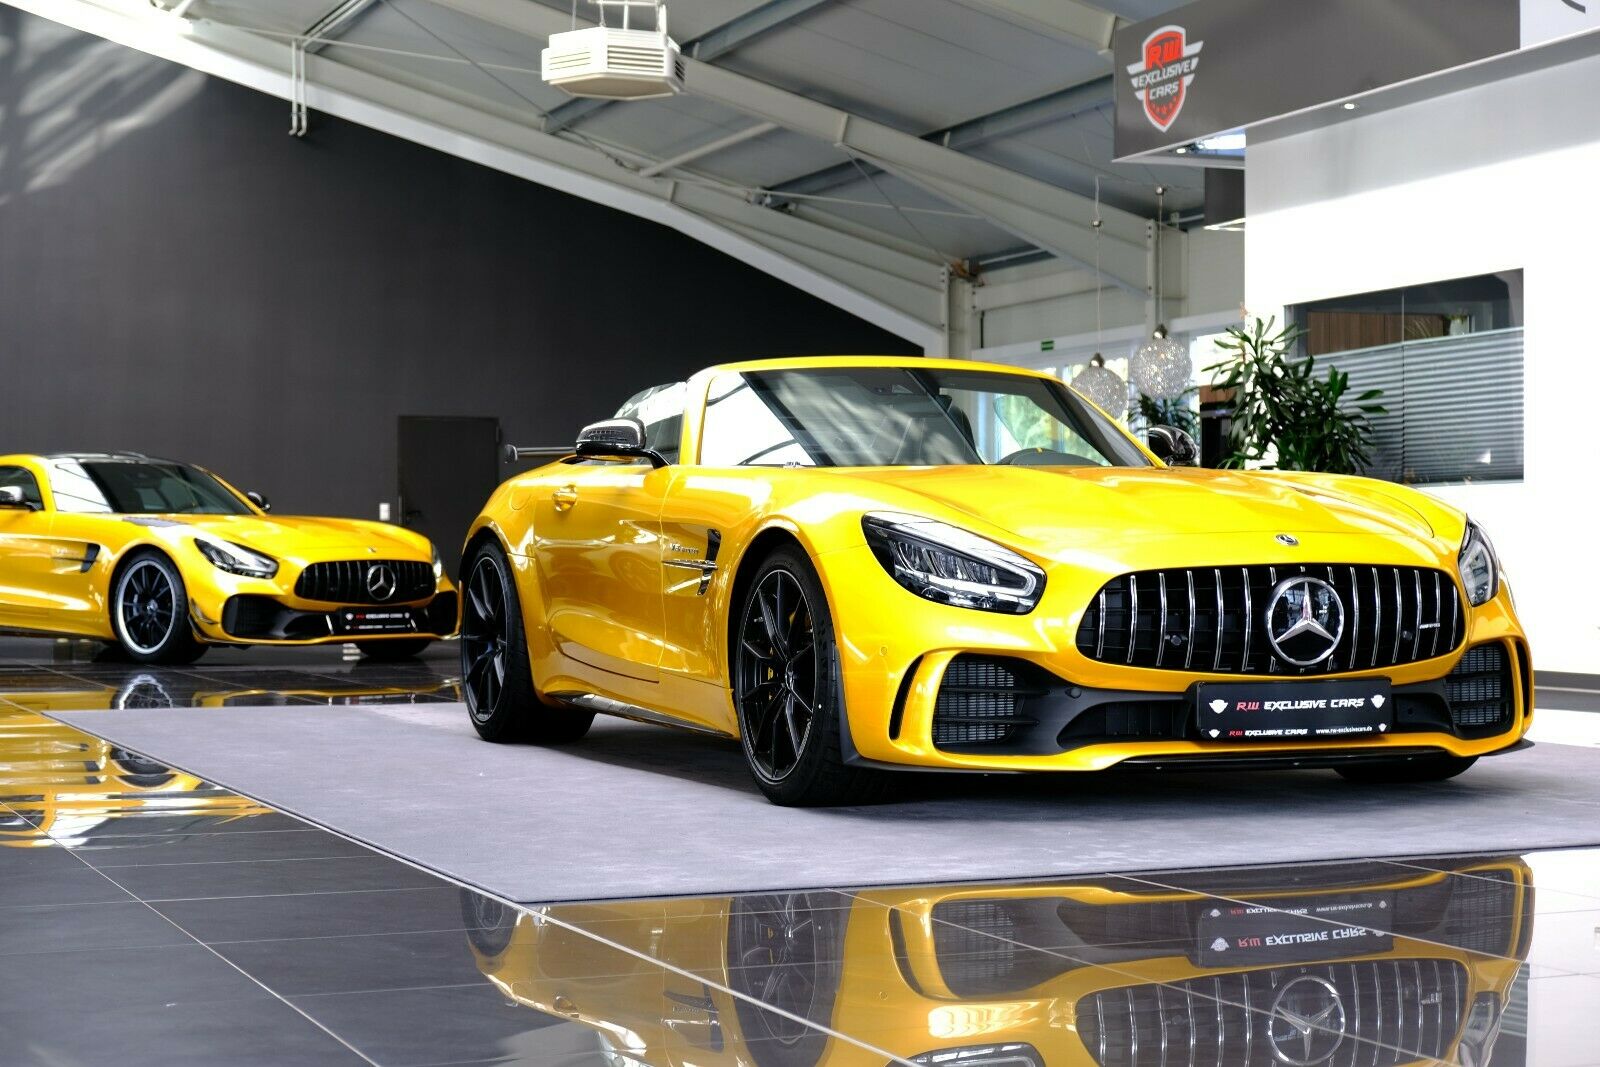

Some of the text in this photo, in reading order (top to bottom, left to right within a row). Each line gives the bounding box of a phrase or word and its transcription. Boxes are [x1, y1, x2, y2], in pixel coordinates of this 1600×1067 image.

[1148, 40, 1182, 70] RW
[1138, 60, 1190, 87] EXCLUSIVE
[1149, 81, 1179, 100] CARS
[1263, 700, 1327, 711] EXCLUSIVE
[1330, 698, 1365, 708] CARS
[1245, 729, 1283, 737] EXCLUSIVE
